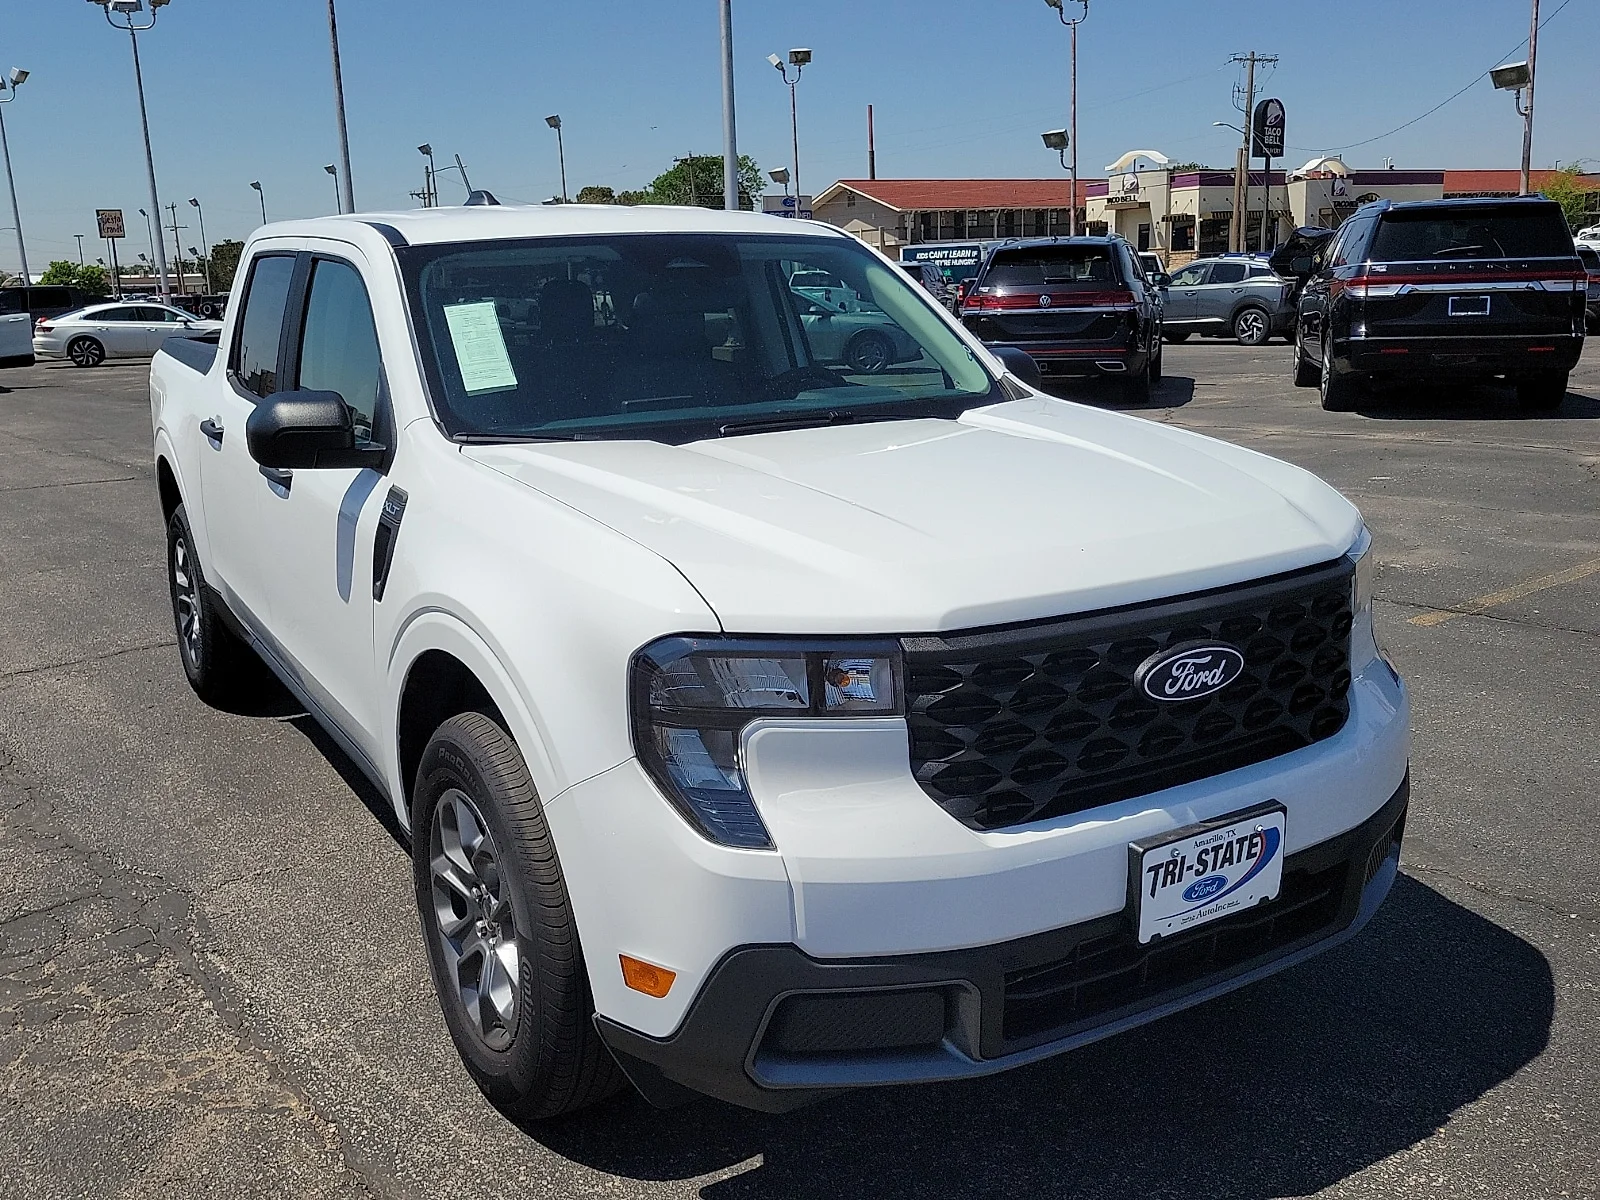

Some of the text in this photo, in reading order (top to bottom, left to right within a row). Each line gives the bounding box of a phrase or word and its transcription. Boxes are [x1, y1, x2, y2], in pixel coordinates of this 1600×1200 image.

[1264, 127, 1281, 136] TACO
[1264, 136, 1280, 144] BELL
[1121, 195, 1138, 203] BELL
[929, 250, 949, 259] CAN'T
[949, 249, 971, 258] LEARN
[972, 250, 978, 258] IF
[383, 501, 400, 515] XLT
[1164, 655, 1226, 695] Ford
[1193, 829, 1237, 849] Amarillo, TX
[1146, 832, 1261, 900] TRI-STATE
[1191, 879, 1219, 898] Ford
